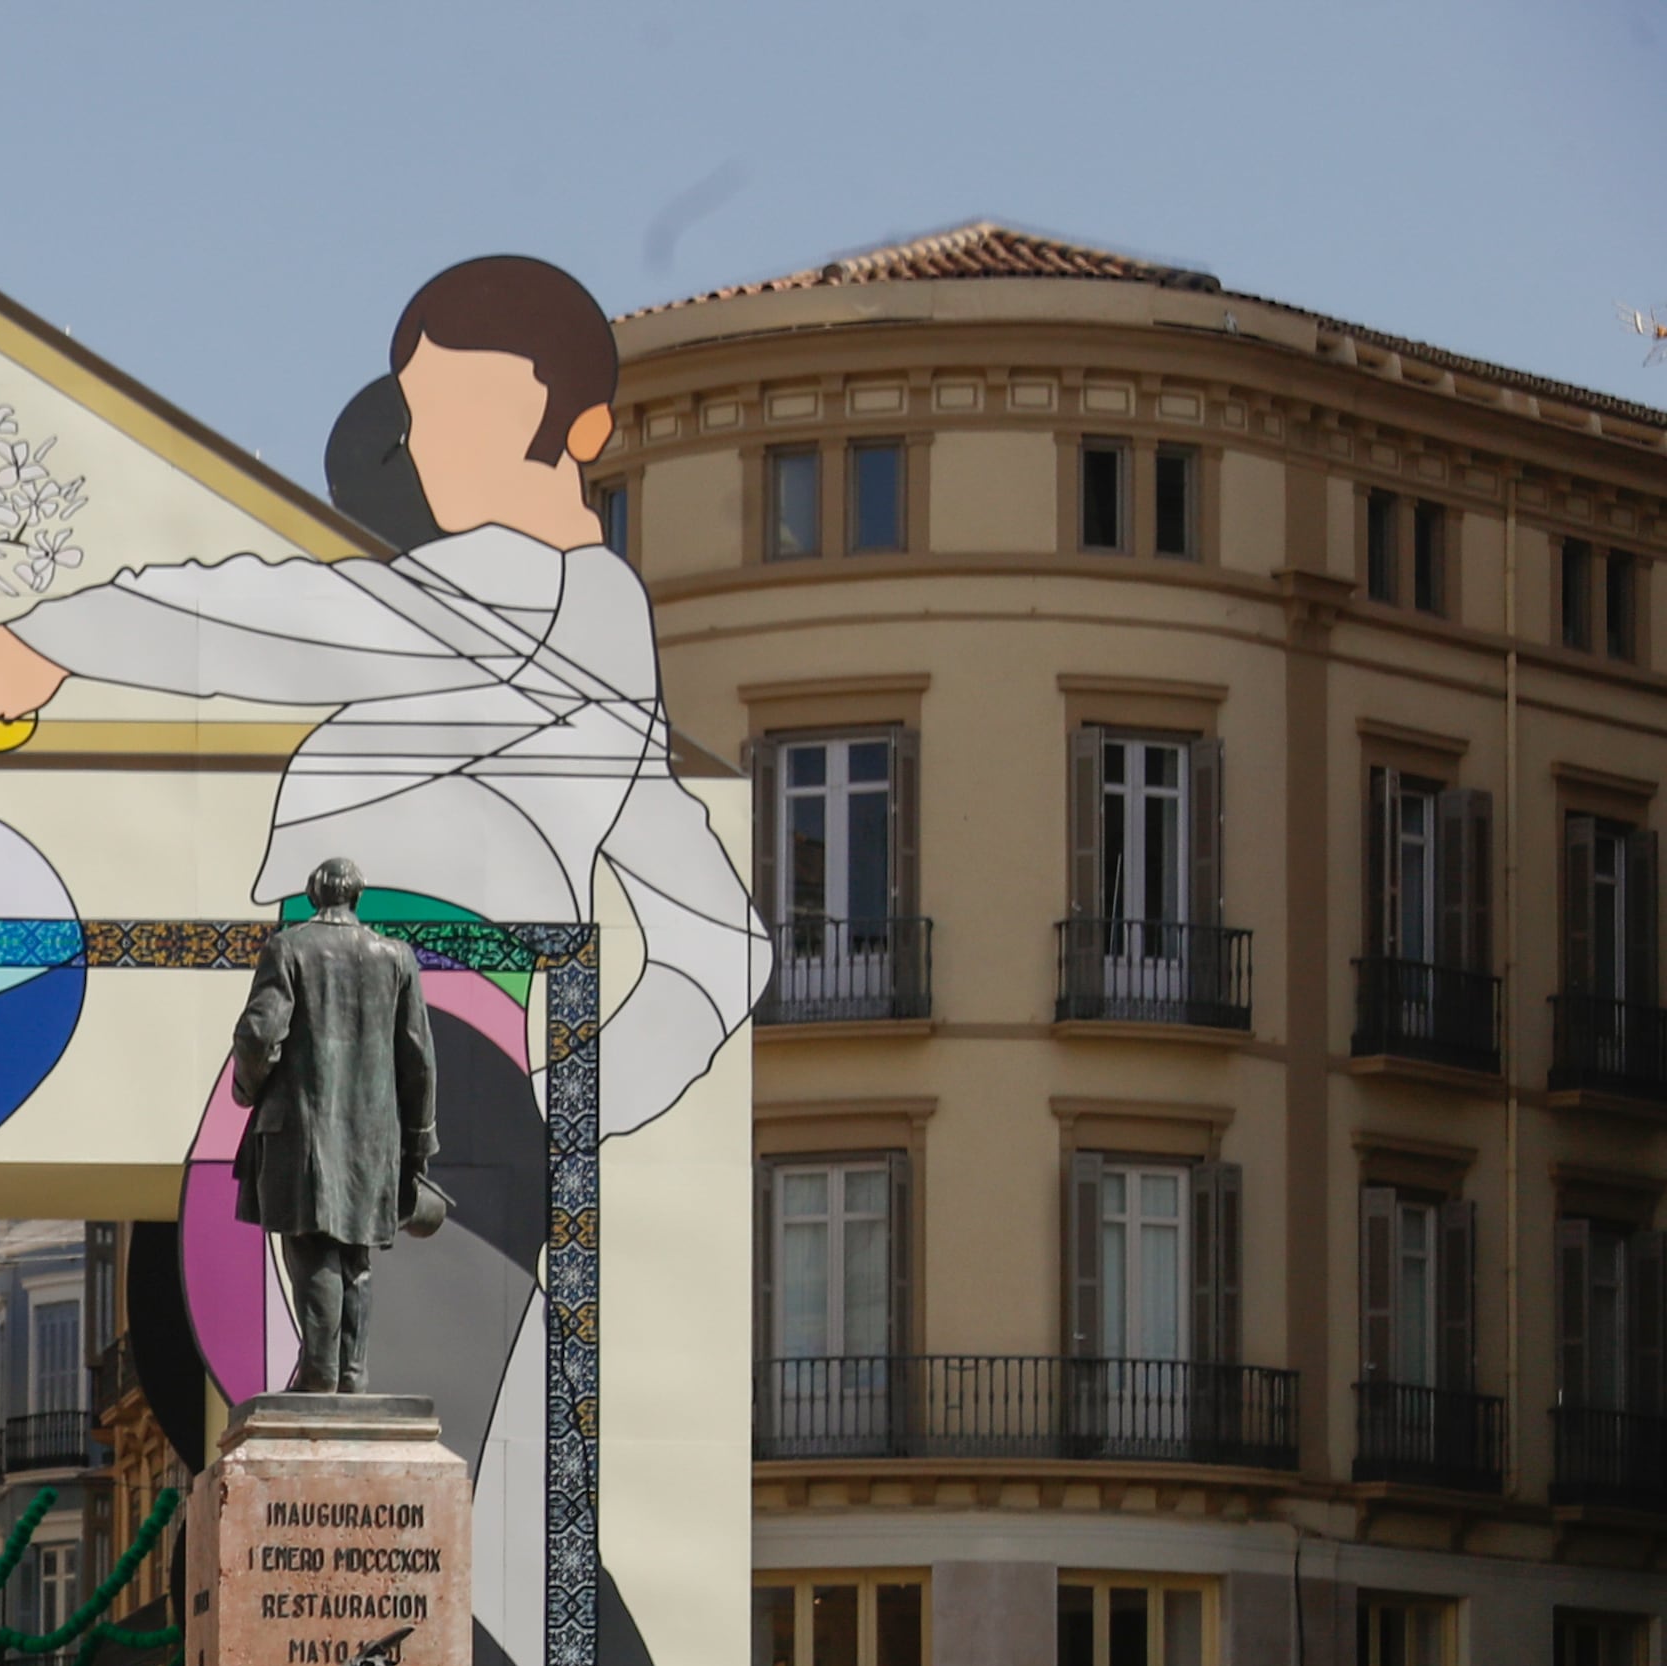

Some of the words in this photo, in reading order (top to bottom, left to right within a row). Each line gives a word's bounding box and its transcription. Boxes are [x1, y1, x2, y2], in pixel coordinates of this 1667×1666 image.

[267, 1502, 424, 1528] INAUGURACION
[262, 1545, 324, 1572] ENERO
[333, 1546, 441, 1573] MDCCCXCIX
[262, 1593, 427, 1619] RESTAURACION
[288, 1639, 349, 1664] MAYO
